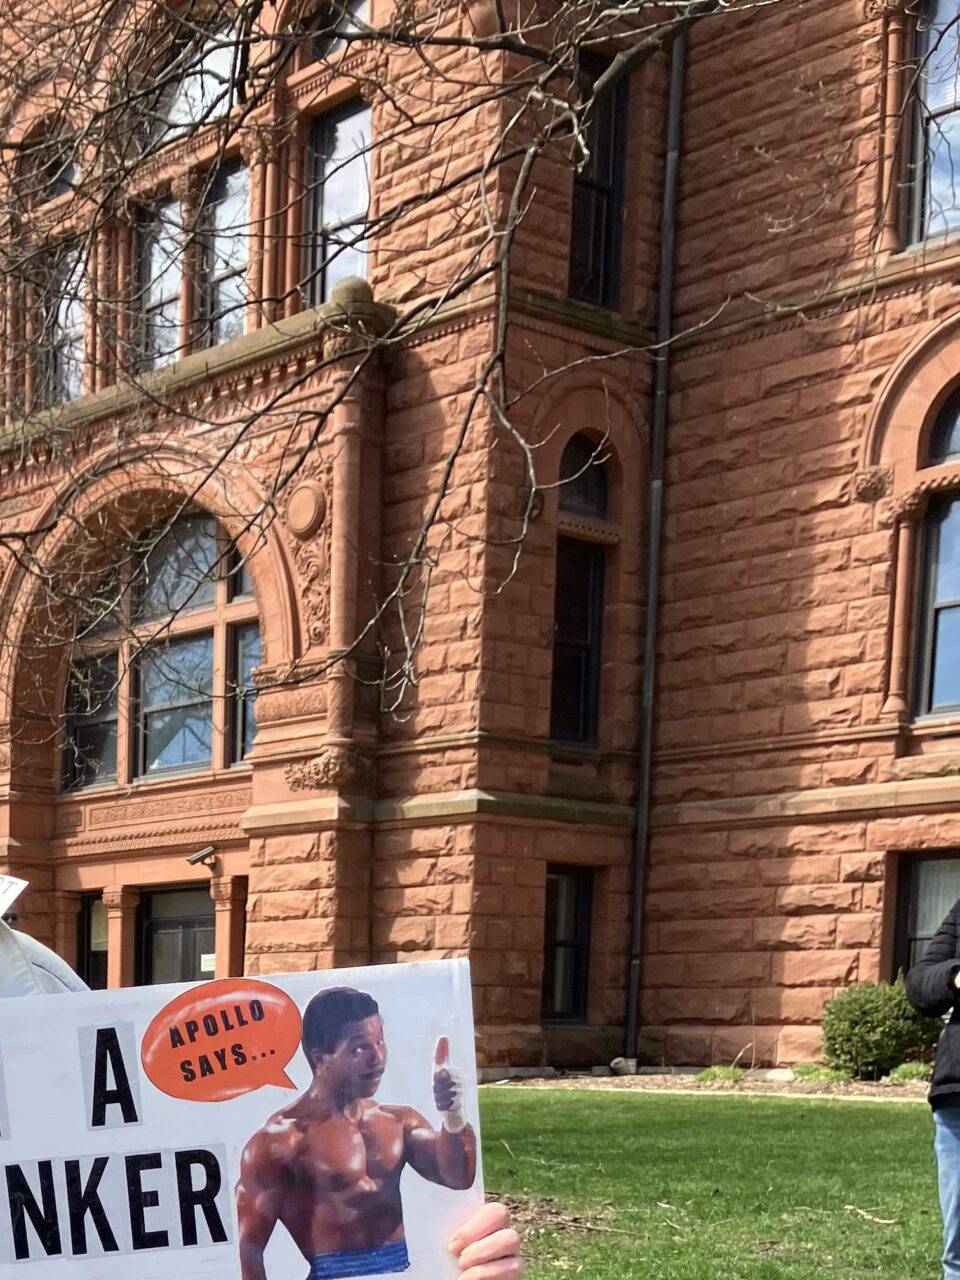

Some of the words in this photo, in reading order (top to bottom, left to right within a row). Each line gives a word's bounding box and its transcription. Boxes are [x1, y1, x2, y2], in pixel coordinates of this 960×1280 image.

[169, 999, 265, 1049] APOLLO
[91, 1027, 139, 1127] A
[180, 1043, 276, 1083] SAYS...
